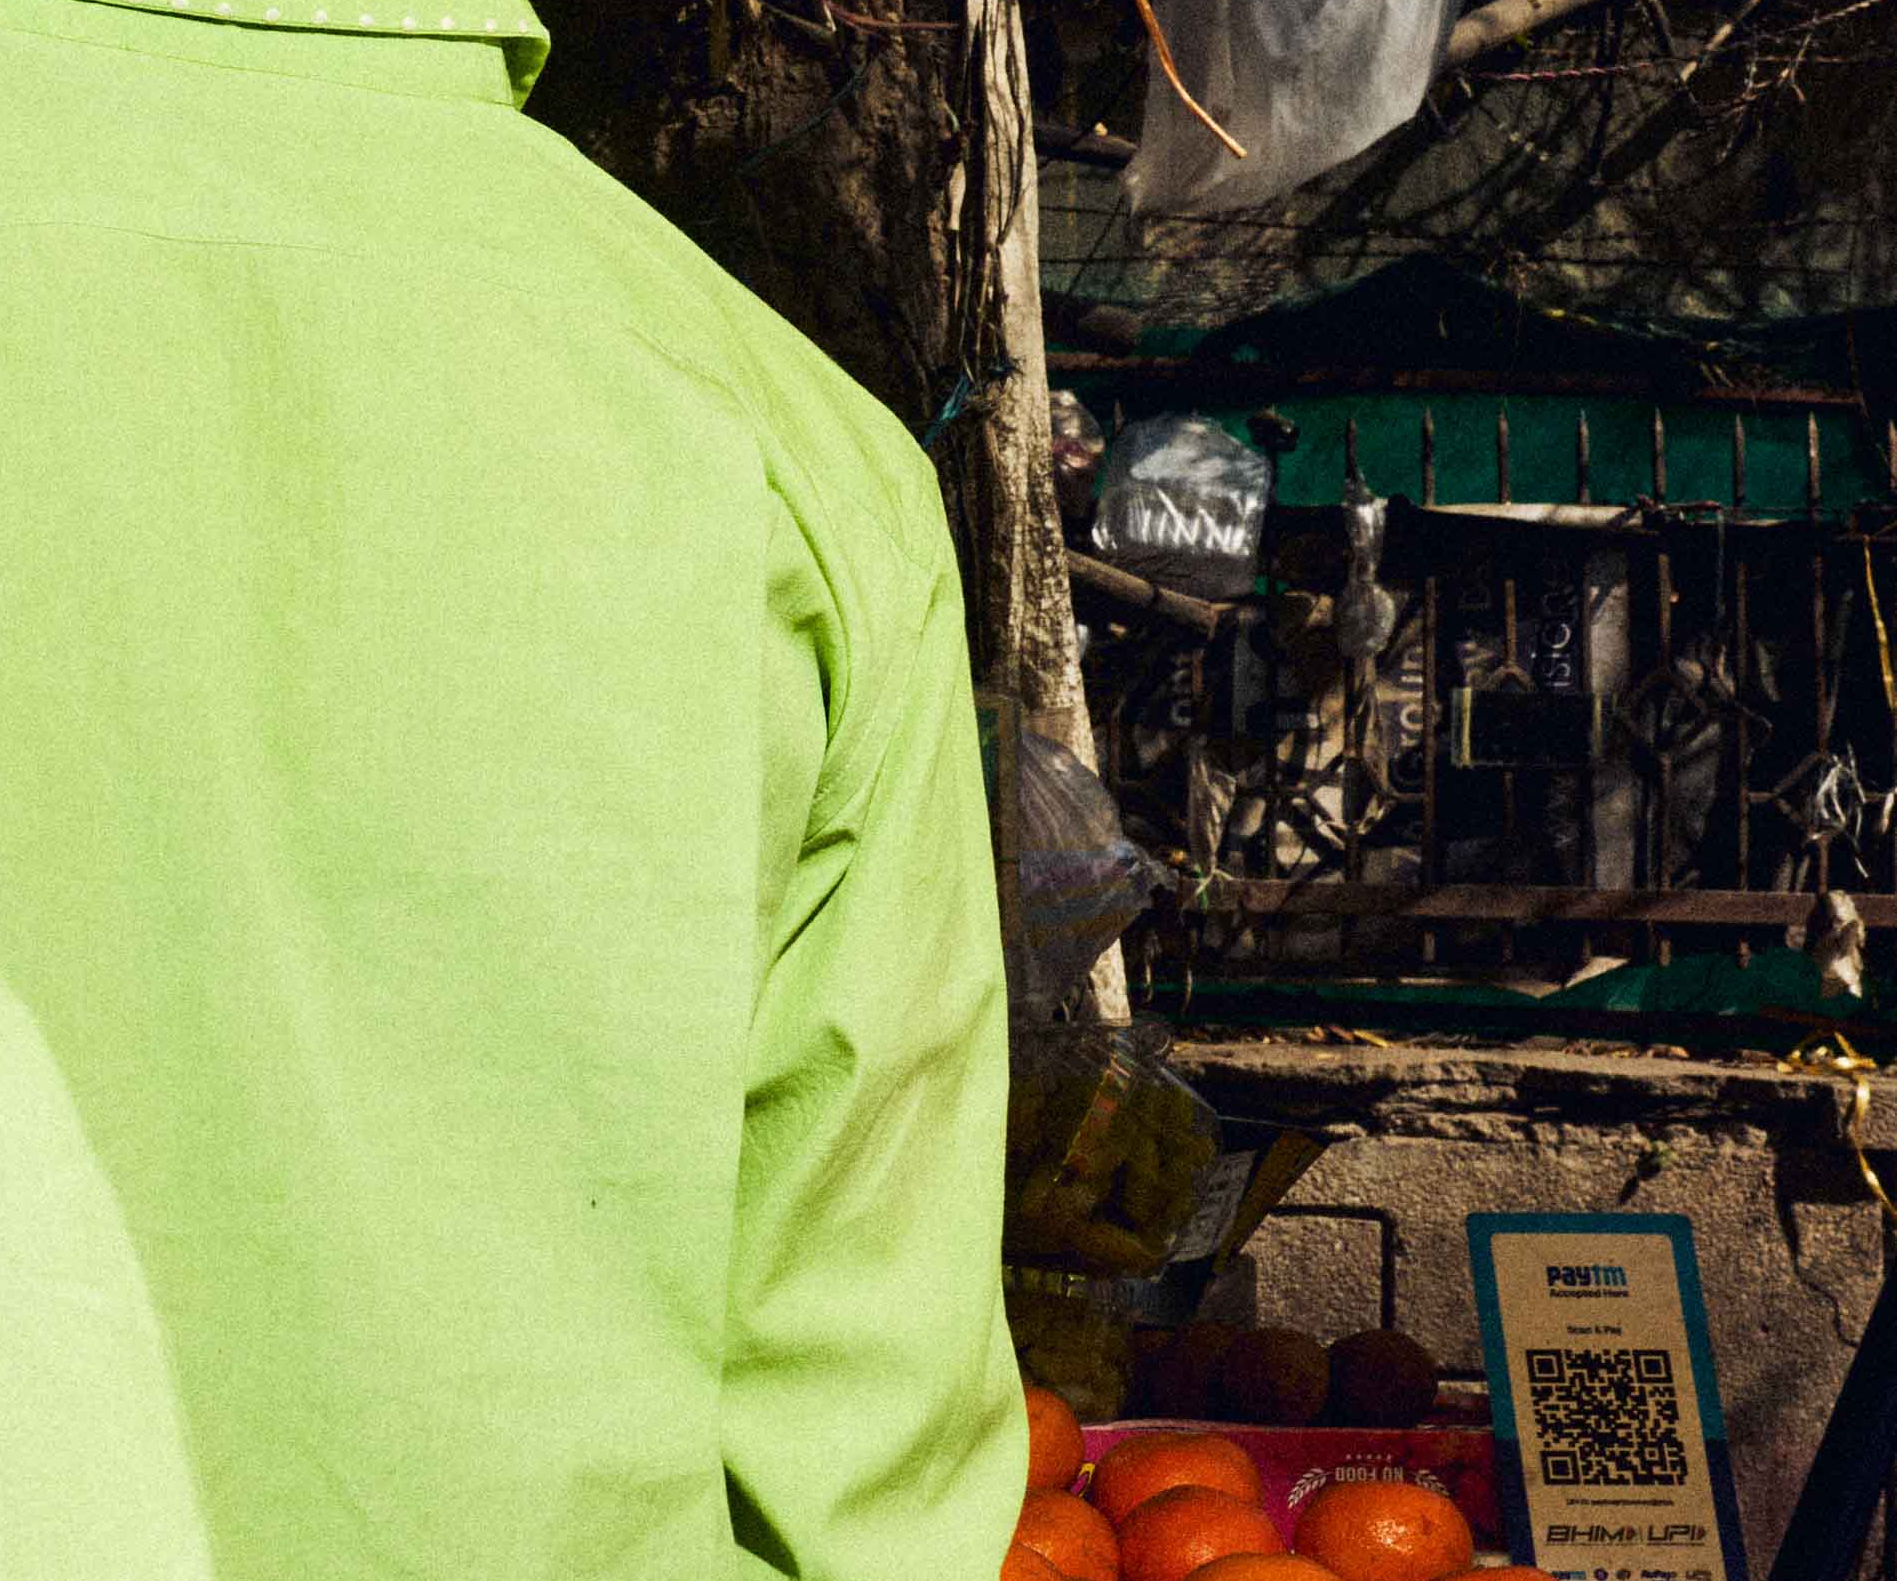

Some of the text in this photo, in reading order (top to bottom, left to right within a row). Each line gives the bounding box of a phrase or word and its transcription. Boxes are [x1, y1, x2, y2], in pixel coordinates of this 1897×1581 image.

[1547, 1265, 1627, 1287] paytm
[1549, 1288, 1629, 1299] Accepted Here
[1567, 1325, 1588, 1335] Scan
[1601, 1325, 1622, 1336] Pay
[1335, 1466, 1376, 1482] FOOD
[1547, 1525, 1695, 1544] BHIM UPI
